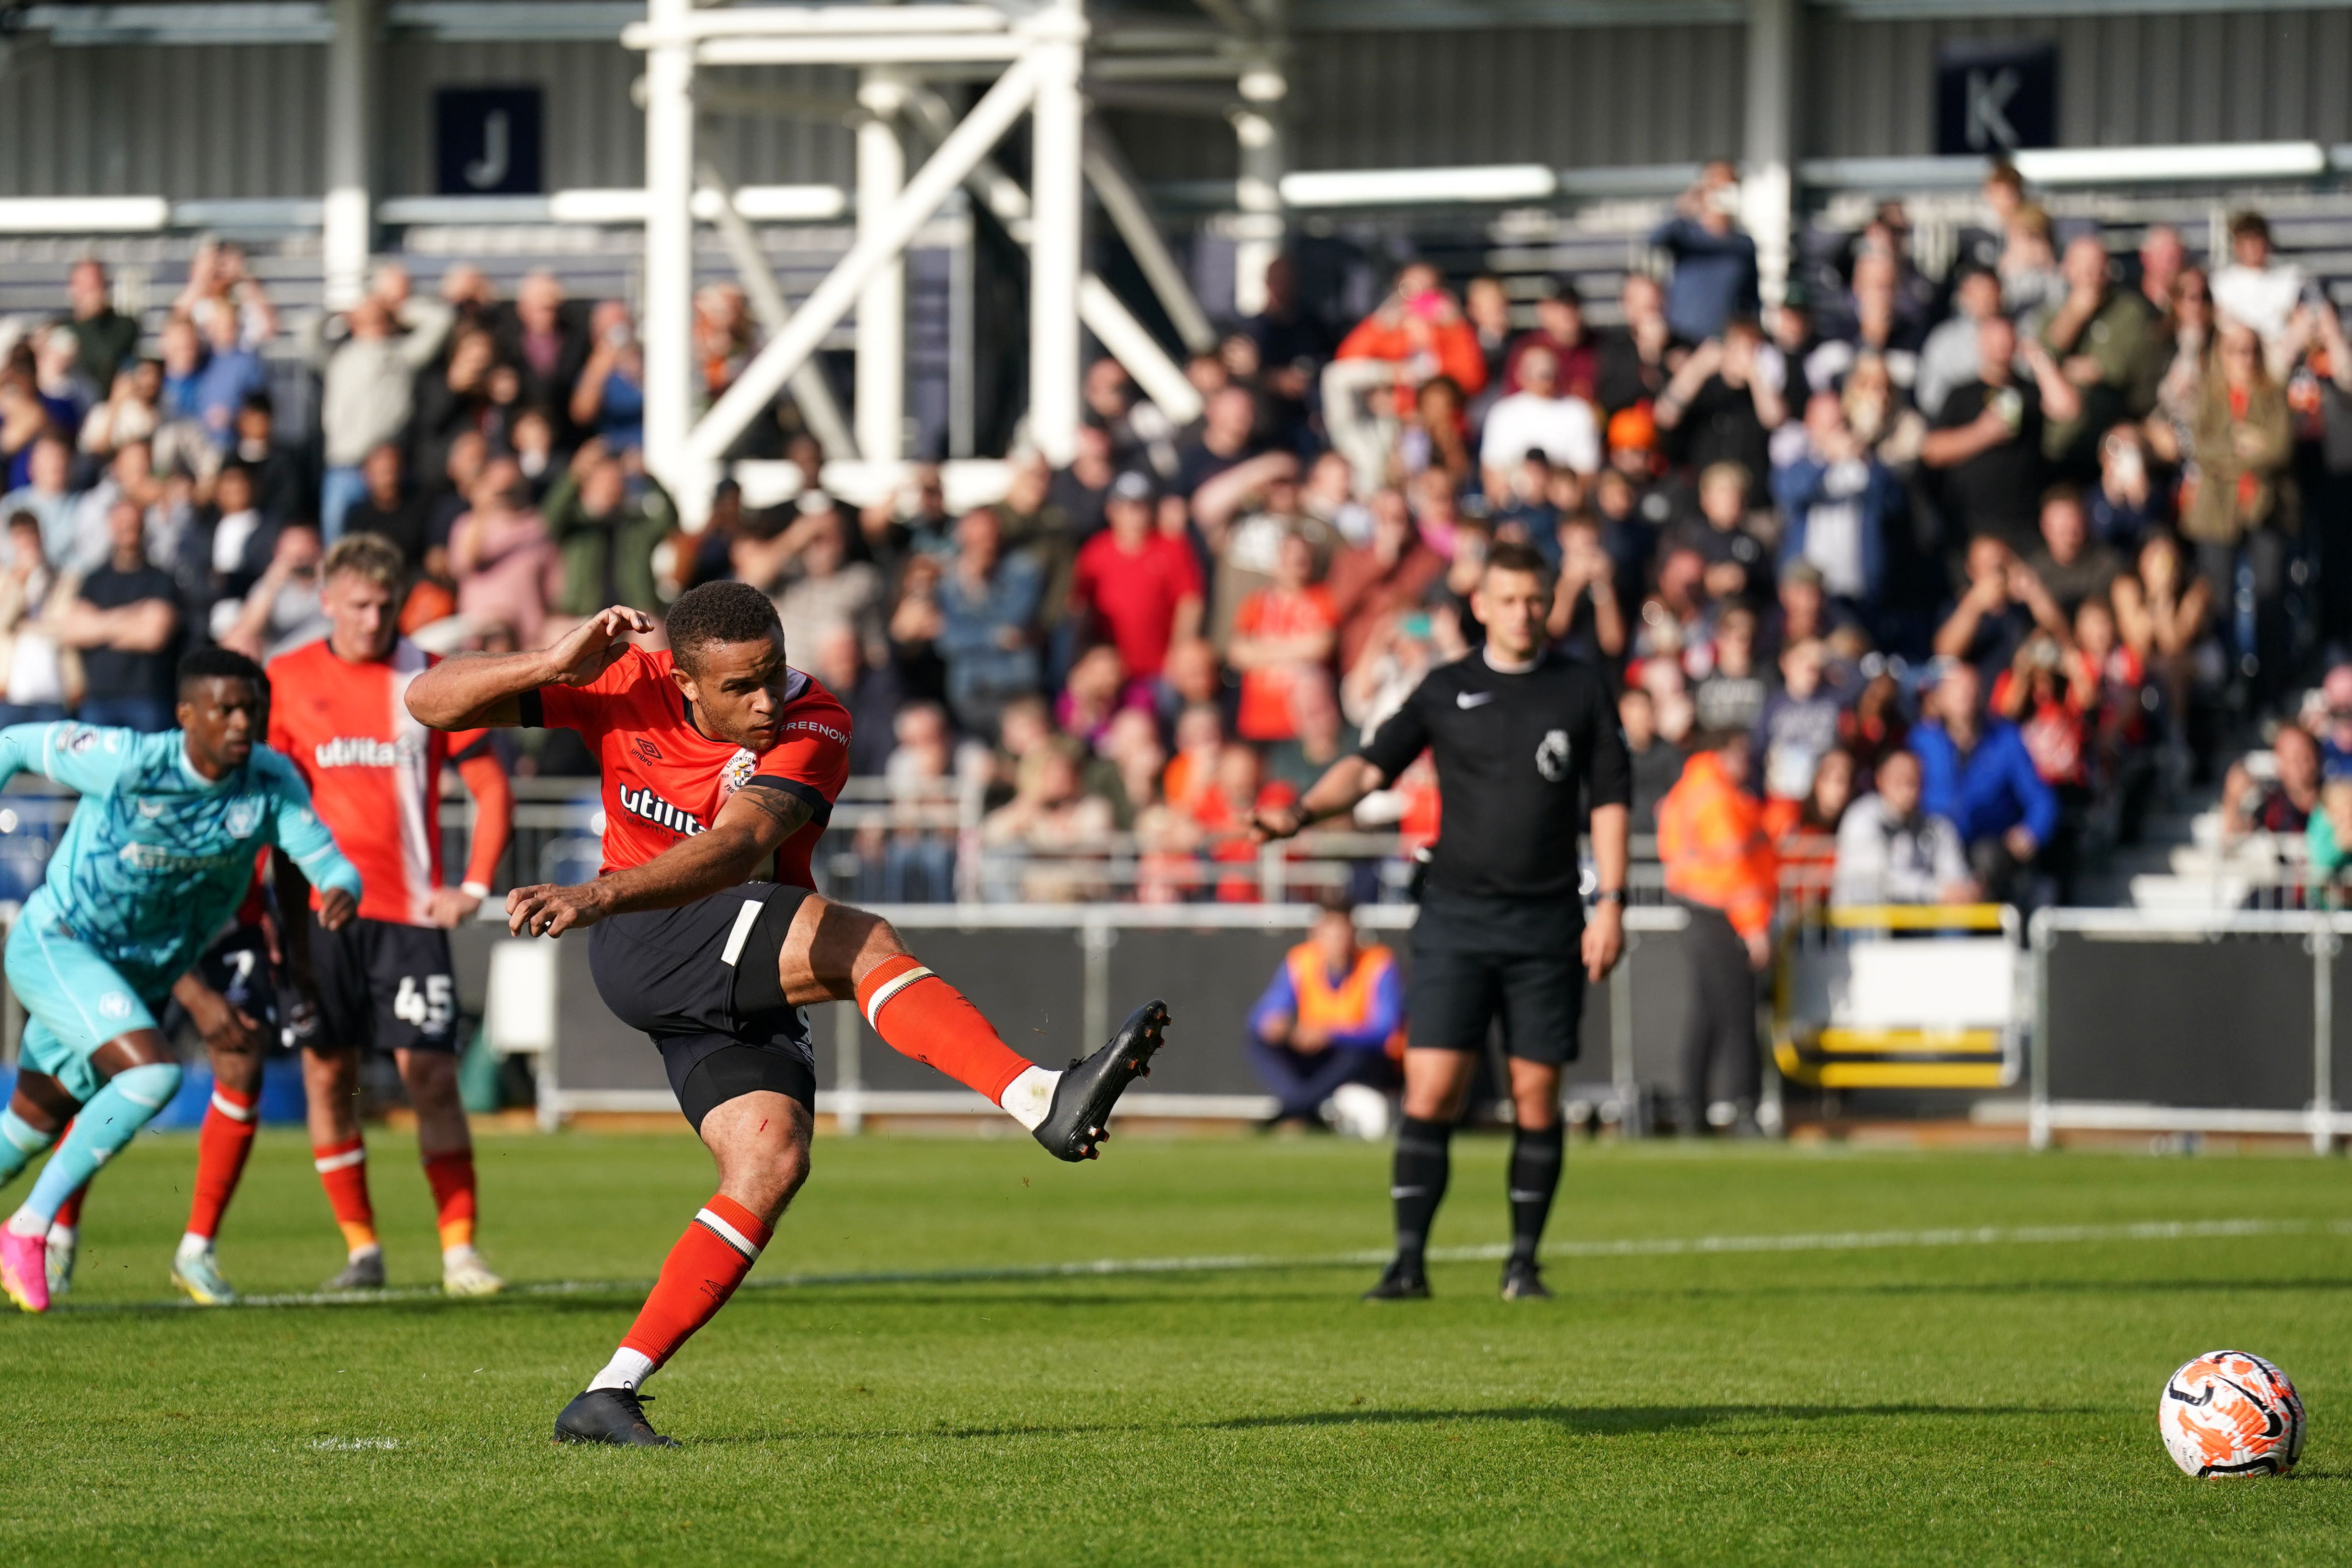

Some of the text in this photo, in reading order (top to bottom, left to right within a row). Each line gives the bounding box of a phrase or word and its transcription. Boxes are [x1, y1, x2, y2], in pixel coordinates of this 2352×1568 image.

[1966, 67, 2019, 150] K
[464, 108, 509, 188] J
[315, 736, 395, 769] utilita
[631, 749, 652, 766] umbro
[726, 756, 742, 768] LUTON
[395, 974, 453, 1026] 45
